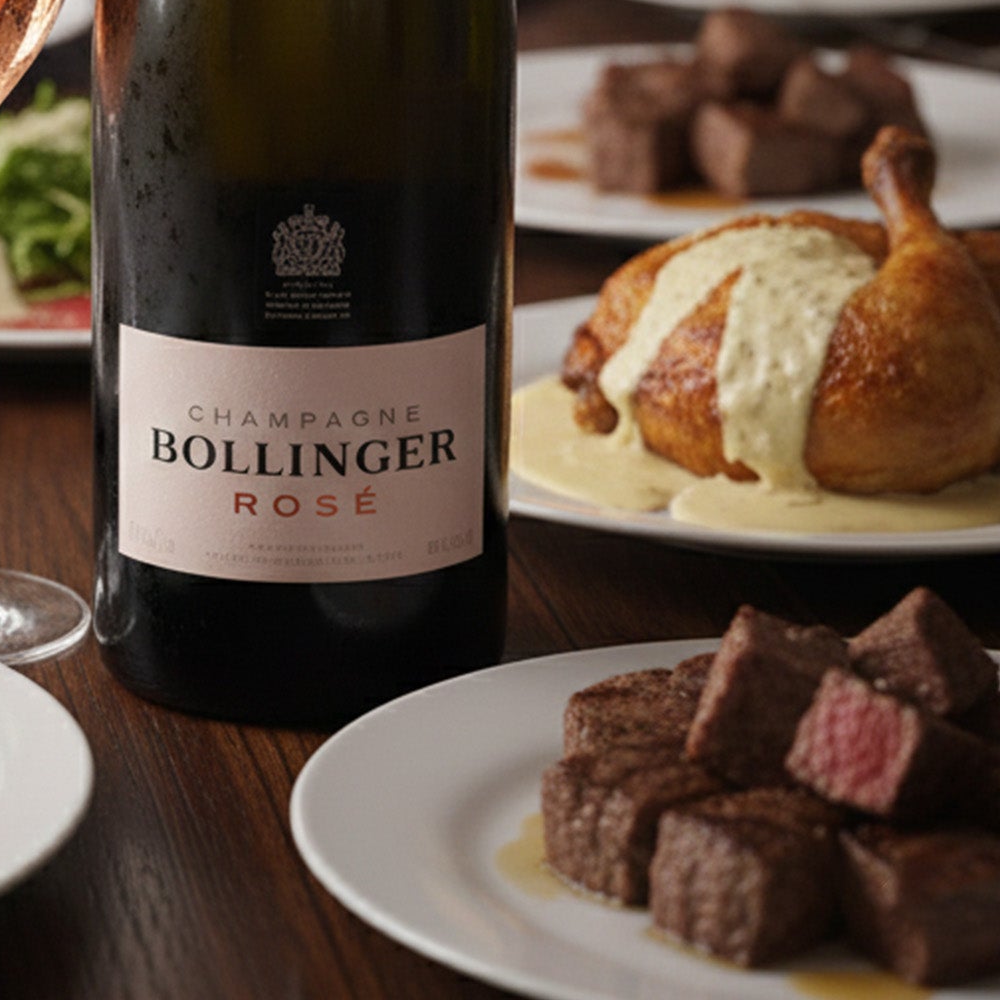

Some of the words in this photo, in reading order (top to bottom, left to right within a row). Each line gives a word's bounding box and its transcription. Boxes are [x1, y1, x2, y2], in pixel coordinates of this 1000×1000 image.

[188, 405, 422, 430] CHAMPAGNE
[151, 427, 457, 477] BOLLINGER
[234, 486, 378, 518] ROSÉ
